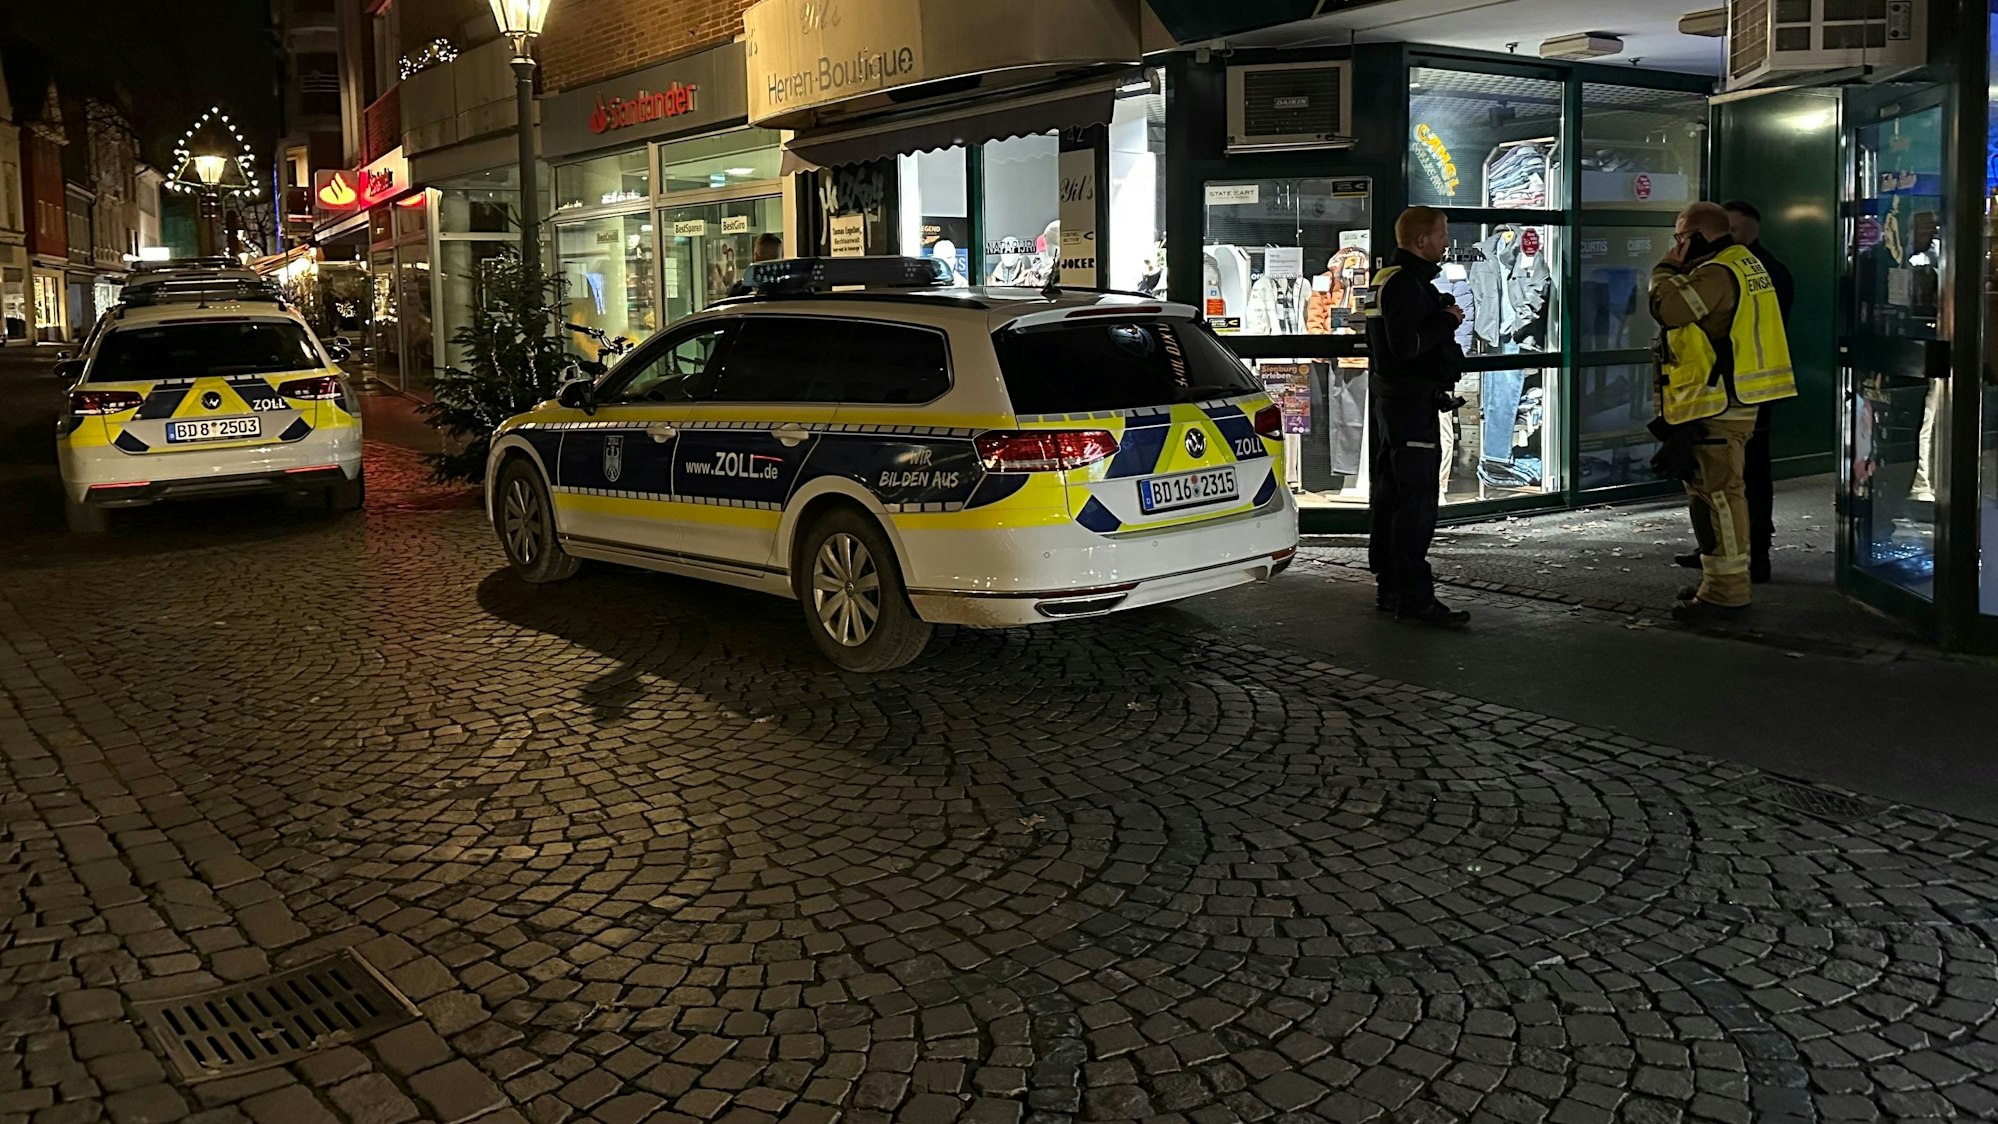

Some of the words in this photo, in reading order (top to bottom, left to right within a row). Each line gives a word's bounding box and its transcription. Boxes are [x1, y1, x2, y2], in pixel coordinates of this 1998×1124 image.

[608, 81, 697, 129] Santander
[1412, 123, 1460, 197] CAMEL
[675, 222, 703, 235] BestSparen
[723, 219, 746, 232] BestGiro
[1062, 257, 1095, 269] JOKER
[1261, 364, 1298, 374] Siegburg
[1261, 372, 1291, 380] erleben
[252, 398, 286, 411] ZOLL
[219, 419, 257, 435] 2503
[1234, 437, 1263, 456] ZOLL
[685, 452, 779, 480] www.ZOLL.de
[909, 449, 932, 467] WIR
[879, 470, 929, 488] BILDEN
[931, 470, 960, 490] AUS
[1152, 481, 1172, 505] BD
[1174, 478, 1192, 502] 16
[1200, 471, 1235, 497] 2315
